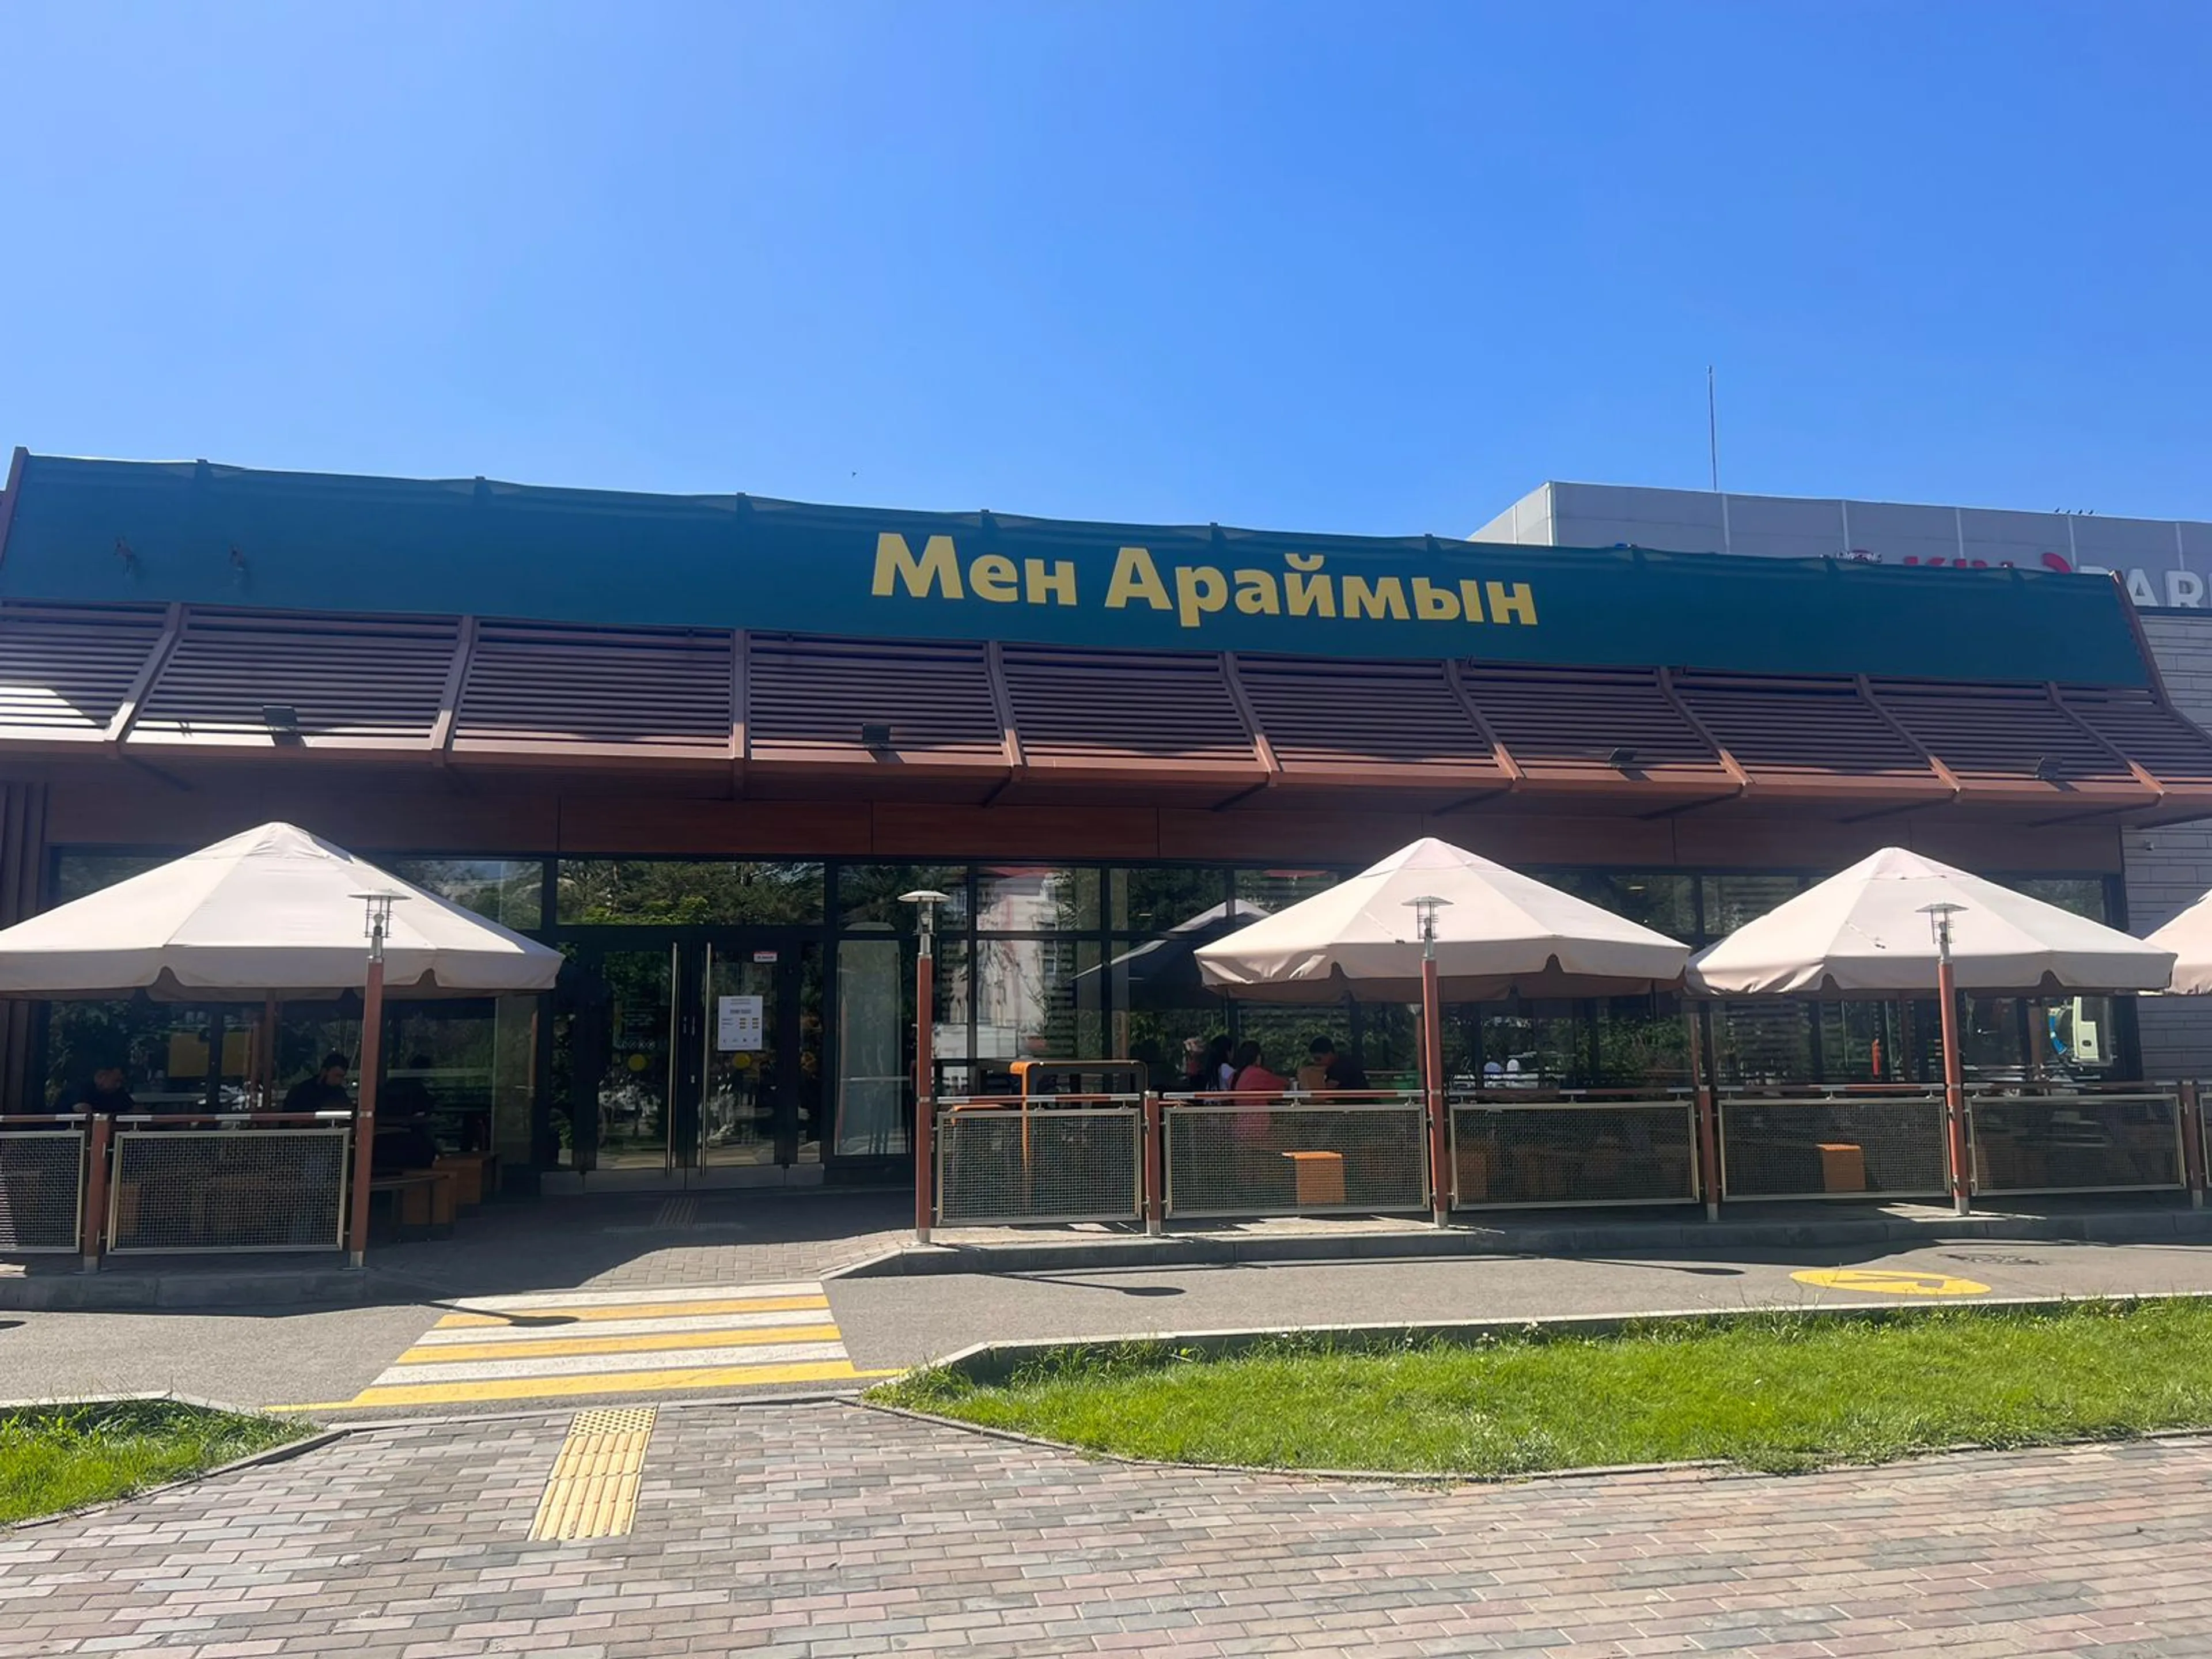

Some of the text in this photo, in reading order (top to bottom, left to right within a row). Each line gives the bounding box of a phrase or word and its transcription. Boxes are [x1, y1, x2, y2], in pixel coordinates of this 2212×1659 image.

[871, 532, 1539, 628] Мен Араймын
[2078, 565, 2212, 608] AR
